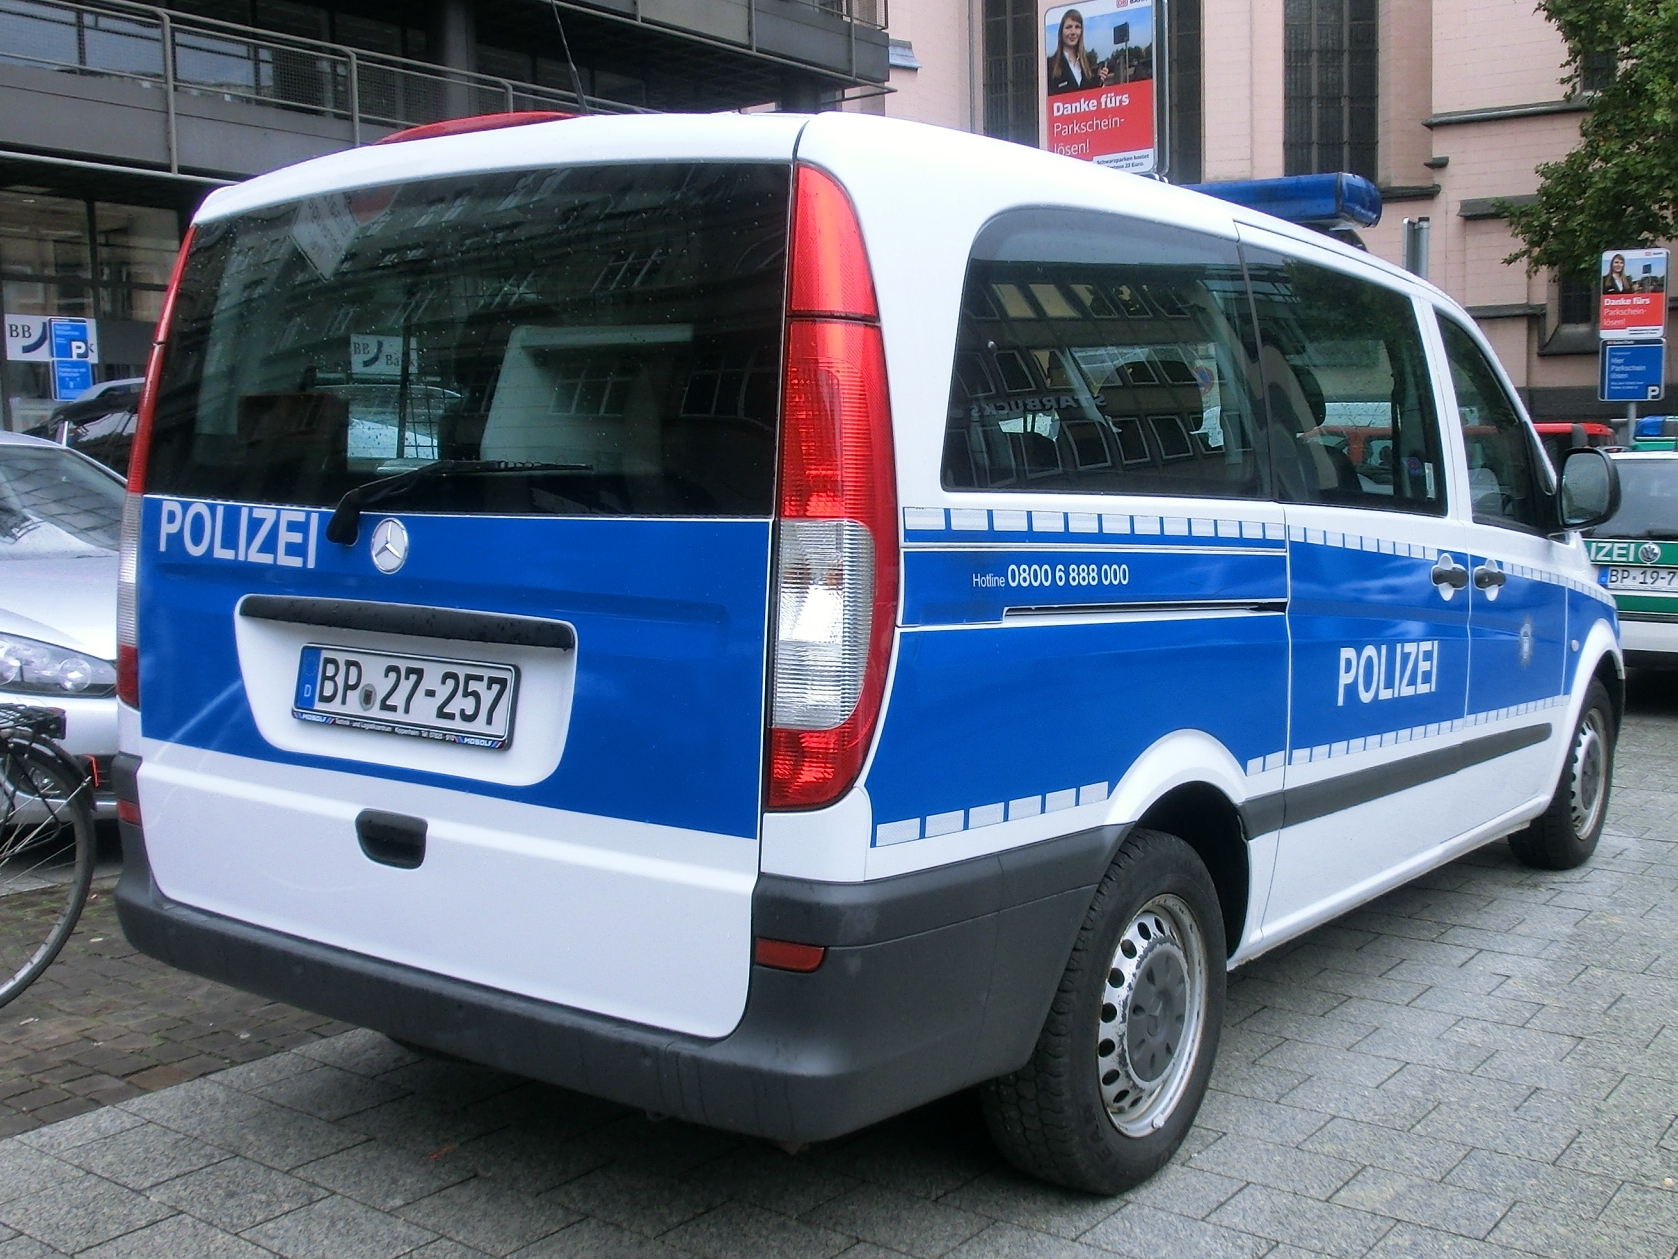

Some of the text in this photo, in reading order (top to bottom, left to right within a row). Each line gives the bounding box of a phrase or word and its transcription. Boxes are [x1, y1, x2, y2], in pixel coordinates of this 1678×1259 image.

[1053, 93, 1130, 117] Danke fürs
[1053, 115, 1125, 137] Parkschein-
[1054, 139, 1090, 156] lösen!
[1604, 298, 1632, 306] Danke
[8, 323, 32, 339] BB
[71, 341, 86, 359] P
[1647, 386, 1660, 400] P
[159, 500, 319, 569] POLIZEI
[1590, 542, 1636, 562] IZEI
[972, 564, 1129, 588] Hotline 0800 6 888 000
[1337, 640, 1439, 707] POLIZEI
[379, 664, 508, 726] 27-257
